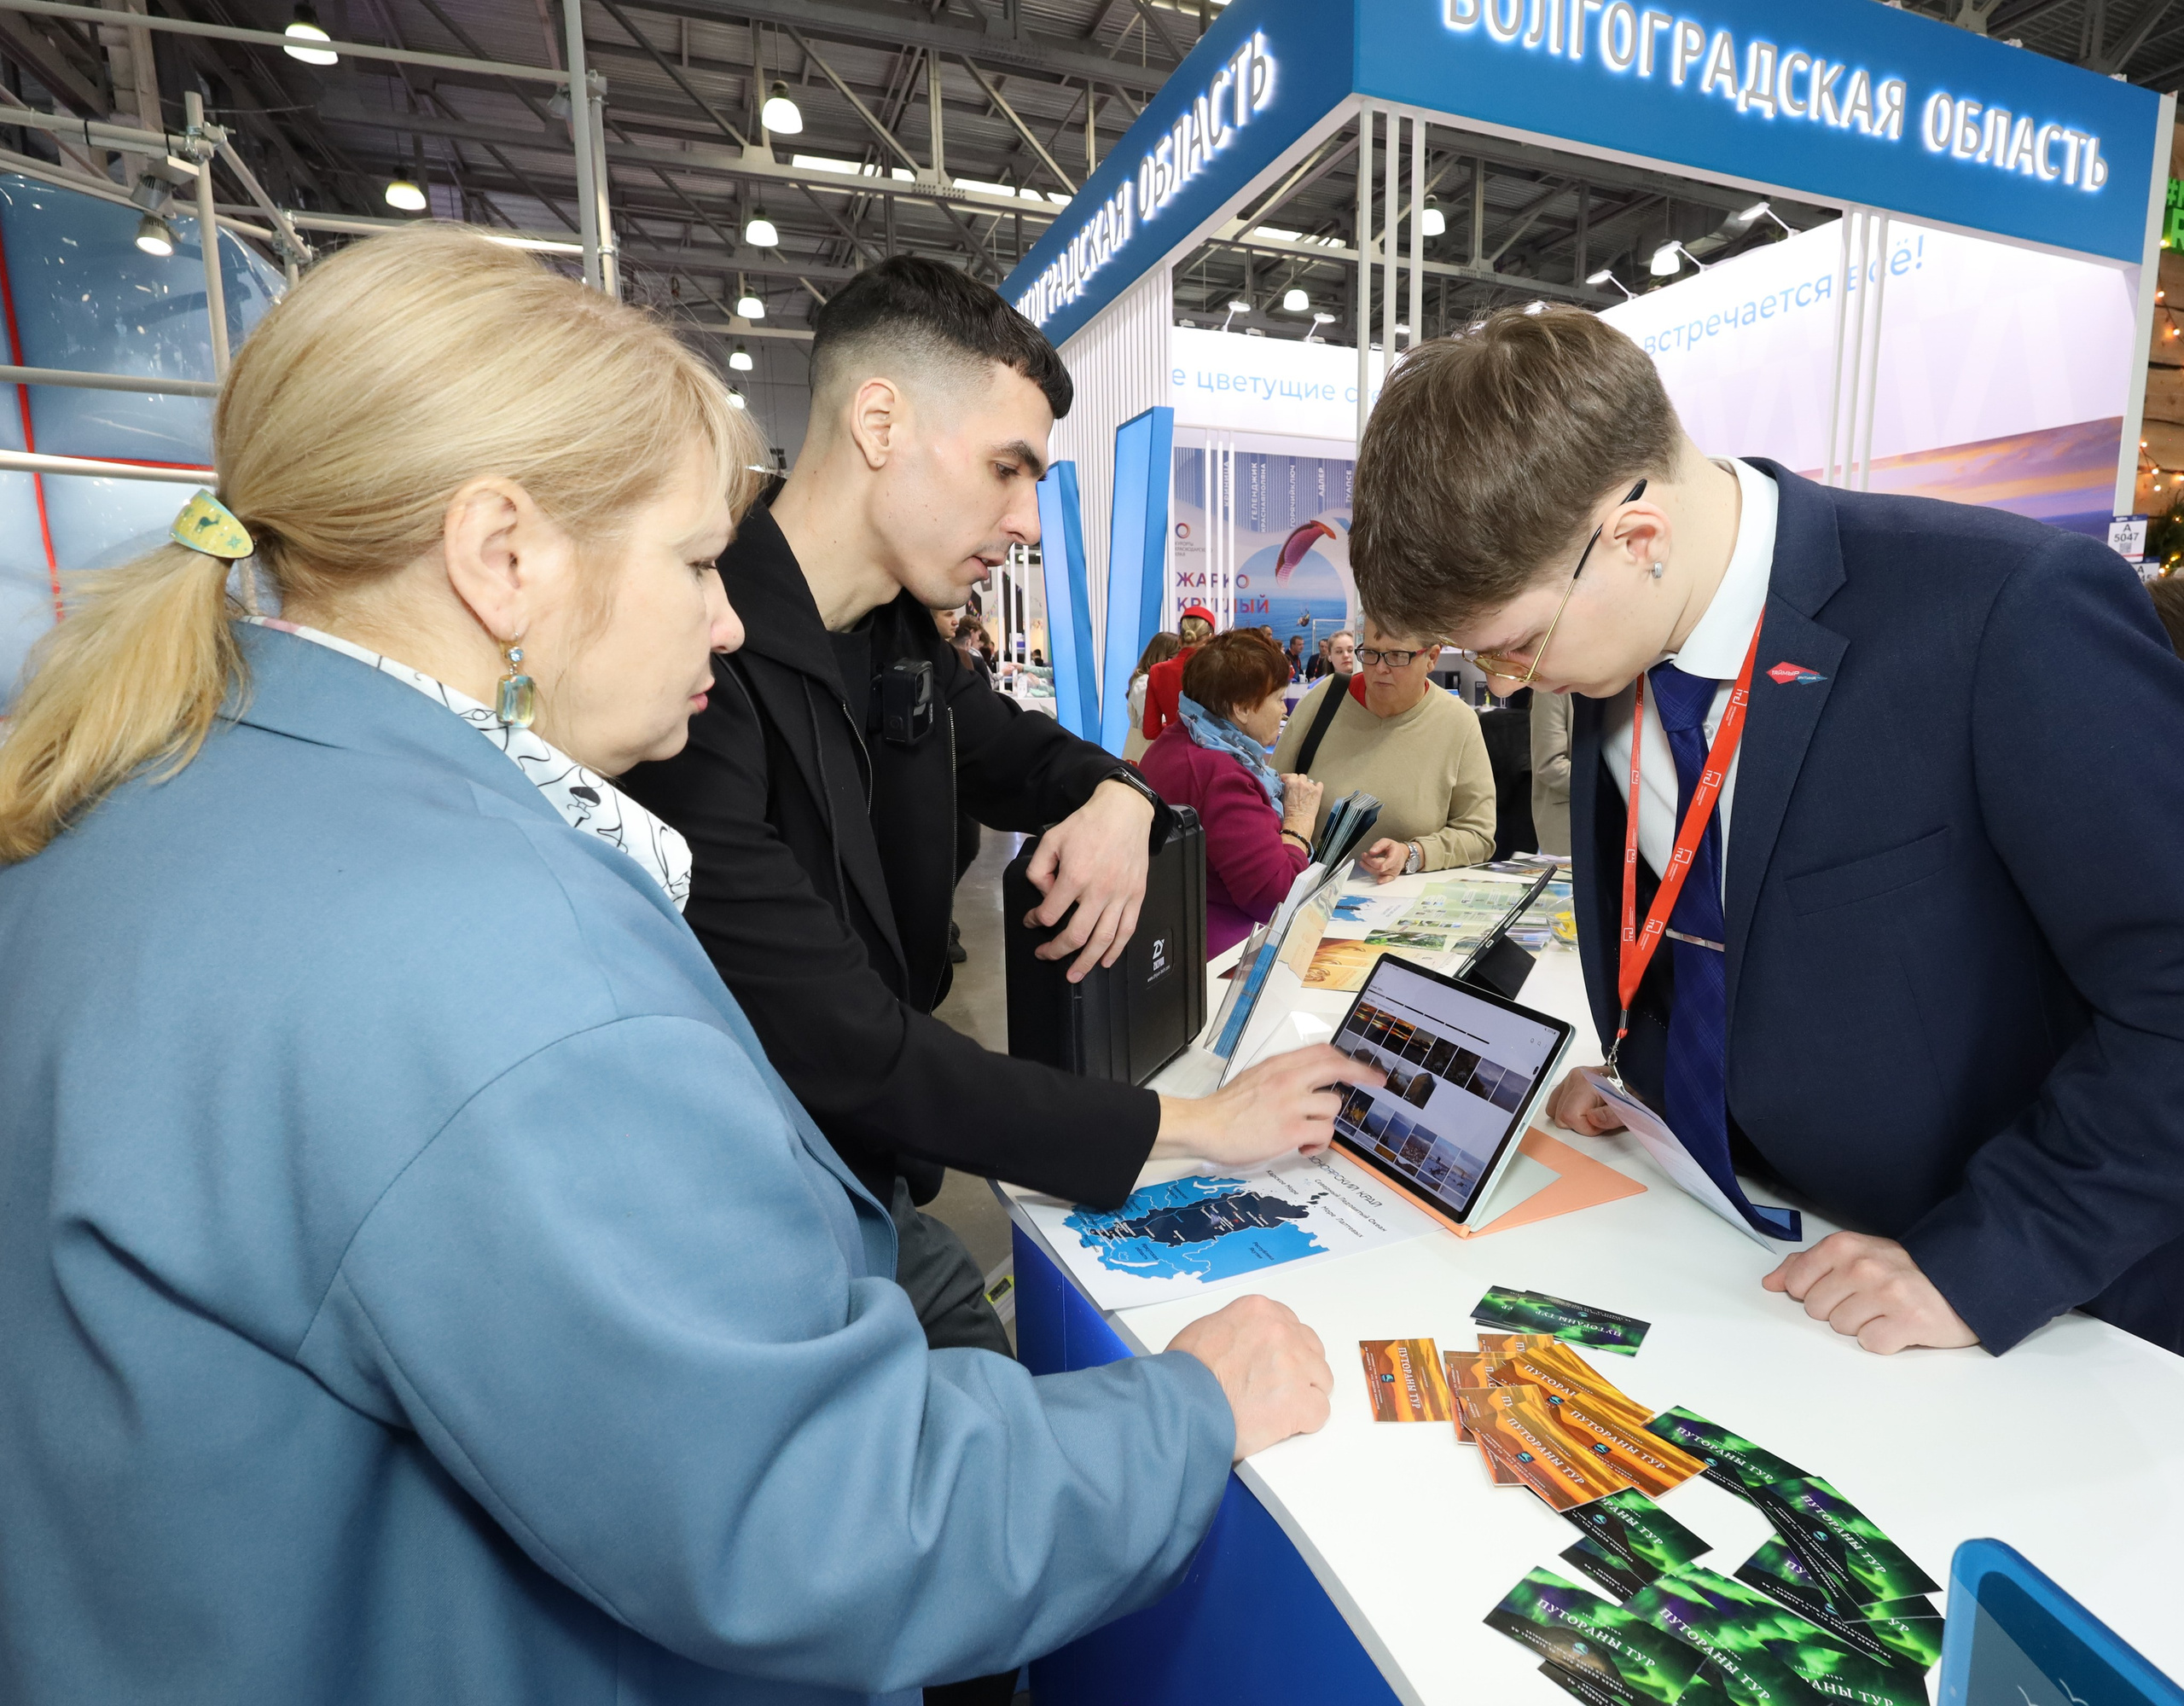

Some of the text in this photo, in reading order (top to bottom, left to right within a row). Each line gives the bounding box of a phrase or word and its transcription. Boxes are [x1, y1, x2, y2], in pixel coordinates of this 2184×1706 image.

[1137, 32, 1275, 223] ОБЛАСТЬ
[1924, 91, 2109, 191] ОБЛАСТЬ
[1644, 274, 1833, 356] встречается
[1197, 371, 1336, 401] цветущие
[2113, 532, 2140, 543] 5047
[1176, 572, 1250, 589] ЖАРКО
[1398, 1347, 1421, 1409] ПУТОРАНЫ ТУР
[1507, 1418, 1586, 1484] ПУТОРАНЫ ТУР
[1570, 1410, 1666, 1470] ПУТОРАНЫ ТУР
[1676, 1426, 1774, 1481] ПУТОРАНЫ ТУР
[1639, 1525, 1664, 1546] ТУР
[1800, 1494, 1888, 1574] ПУТОРАНЫ ТУР
[1536, 1598, 1656, 1668] ПУТОРАНЫ ТУР
[1658, 1607, 1771, 1700] ПУТОРАНЫ ТУР
[1888, 1617, 1910, 1633] УР
